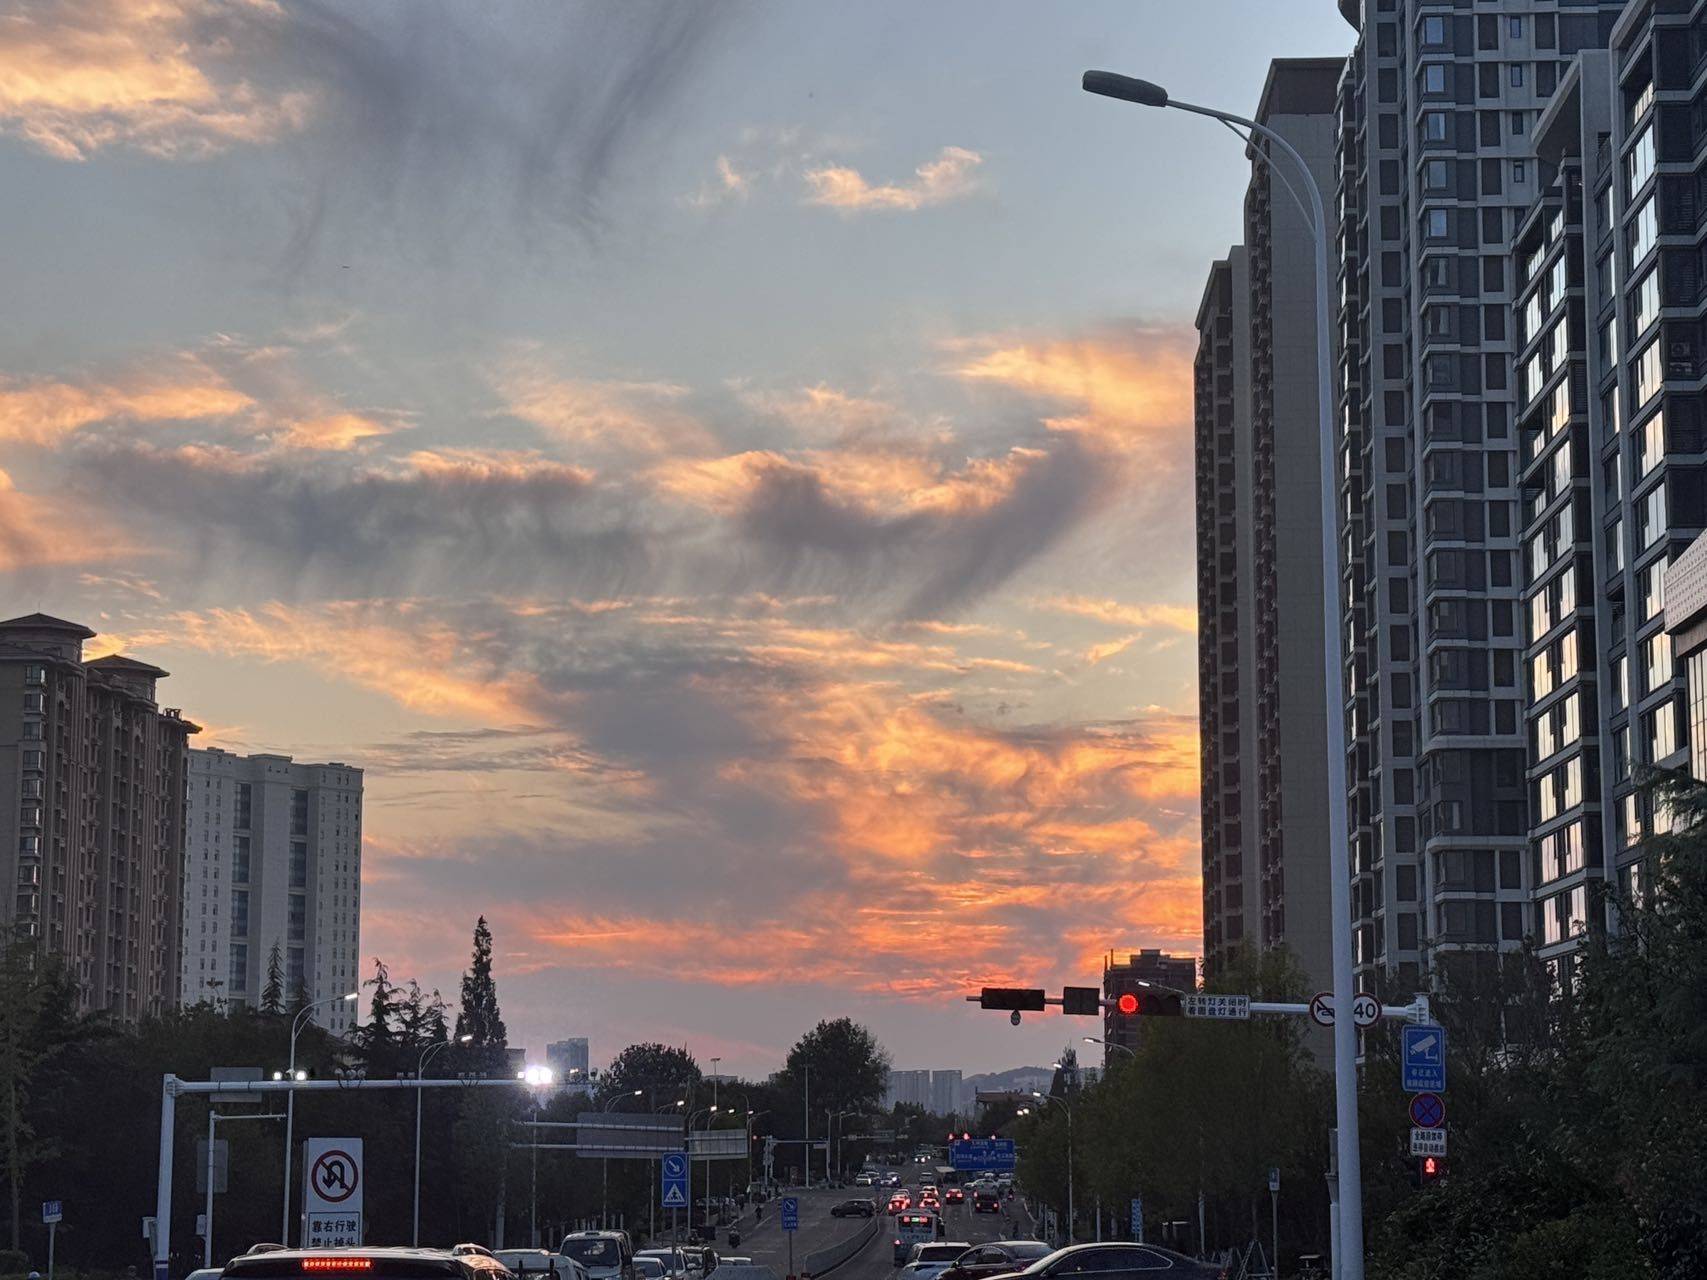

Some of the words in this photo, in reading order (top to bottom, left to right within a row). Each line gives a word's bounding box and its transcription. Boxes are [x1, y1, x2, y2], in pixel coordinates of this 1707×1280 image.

[1188, 996, 1247, 1007] 左转灯关闭时
[1353, 1003, 1377, 1019] 40
[312, 1220, 356, 1233] 靠右行驶
[312, 1236, 356, 1248] 禁止掉头
